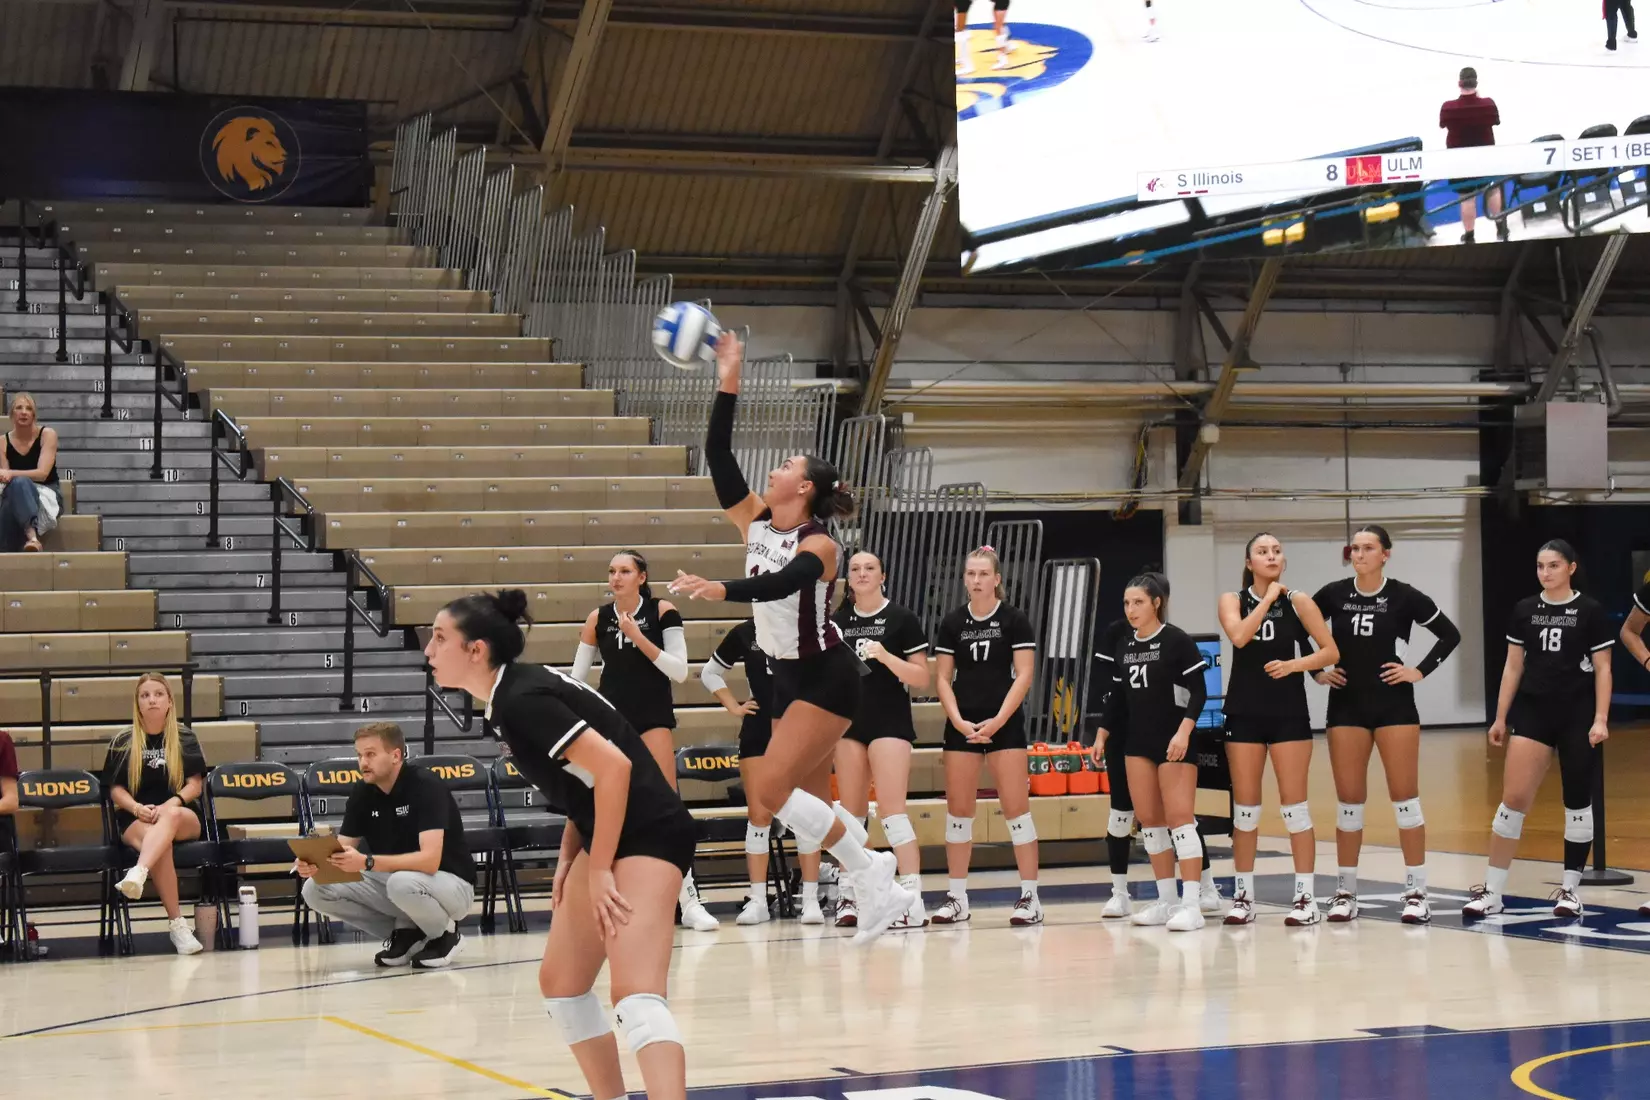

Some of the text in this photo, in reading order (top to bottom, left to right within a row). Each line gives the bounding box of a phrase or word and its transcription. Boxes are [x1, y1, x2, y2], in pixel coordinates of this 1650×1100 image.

[1543, 147, 1557, 165] 7
[1572, 146, 1604, 162] SET
[1611, 145, 1618, 159] 1
[1387, 156, 1422, 172] ULM
[1177, 170, 1243, 187] S Illinois
[1326, 164, 1338, 181] 8
[118, 409, 129, 420] 12
[141, 439, 153, 449] 11
[166, 470, 179, 481] 10
[197, 502, 204, 514] 9
[117, 538, 124, 550] D
[226, 537, 233, 549] 8
[257, 575, 264, 587] 7
[175, 614, 182, 628] D
[290, 612, 297, 625] 6
[1351, 613, 1374, 636] 15
[1539, 628, 1562, 651] 18
[970, 640, 990, 661] 17
[325, 654, 332, 667] 5
[1129, 664, 1148, 688] 21
[240, 701, 247, 715] D
[361, 698, 369, 711] 4
[684, 755, 740, 769] LIONS
[317, 769, 363, 784] LION
[431, 763, 475, 780] ONS
[221, 771, 286, 788] LIONS
[22, 779, 90, 796] LIONS
[319, 798, 326, 813] D
[525, 791, 532, 806] E
